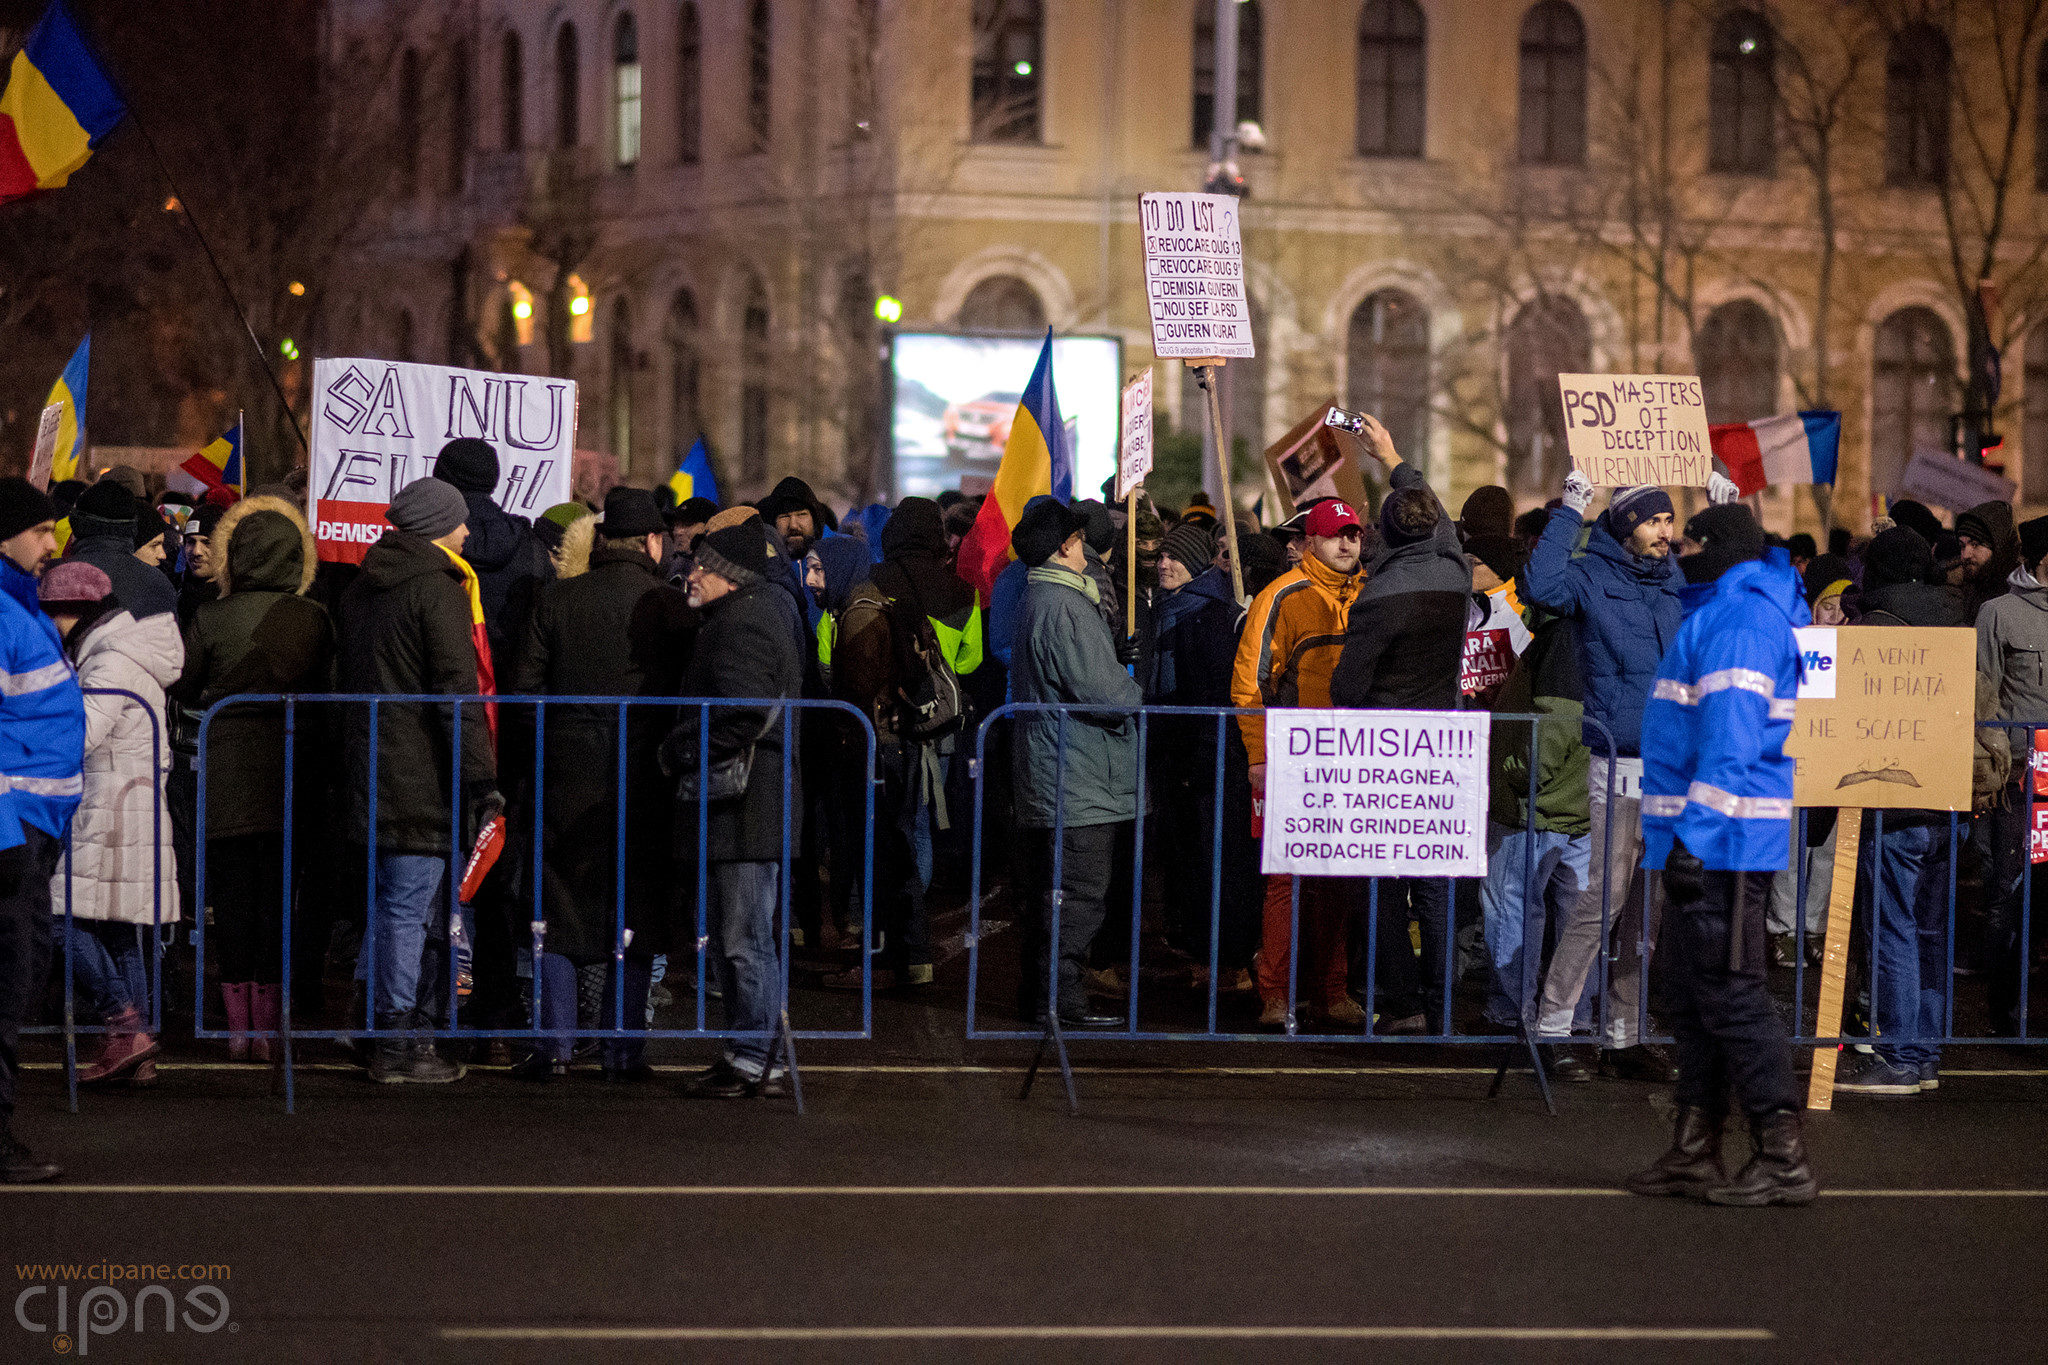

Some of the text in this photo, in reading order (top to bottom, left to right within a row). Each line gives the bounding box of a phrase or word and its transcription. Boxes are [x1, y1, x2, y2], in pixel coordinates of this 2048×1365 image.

[1143, 199, 1160, 231] TO
[1165, 200, 1185, 232] DO
[1191, 200, 1215, 234] LIST
[1158, 237, 1241, 255] REVOCARE OUG 13
[1160, 259, 1212, 275] REVOCARE
[1213, 260, 1232, 276] OUG
[1162, 281, 1239, 298] DEMISIA GUVERN
[1163, 301, 1186, 316] NOU
[1211, 302, 1220, 317] LA
[1220, 303, 1238, 318] PSD
[1166, 323, 1237, 340] GUVERN CURAT
[323, 362, 567, 451] SĂ NU
[1563, 380, 1702, 429] PSD MASTERS
[1639, 407, 1668, 430] OF
[1601, 429, 1701, 453] DECEPTION
[1331, 502, 1350, 518] L
[1851, 647, 1867, 666] A
[1810, 718, 1837, 739] NE
[1855, 719, 1927, 742] SCAPE
[1288, 727, 1474, 759] DEMISIA!!!!
[1303, 767, 1461, 788] LIVIU DRAGNEA,
[1302, 793, 1455, 811] C.P. TARICEANU
[1284, 817, 1472, 837] SORIN GRINDEANU,
[1285, 842, 1469, 861] IORDACHE FLORIN.
